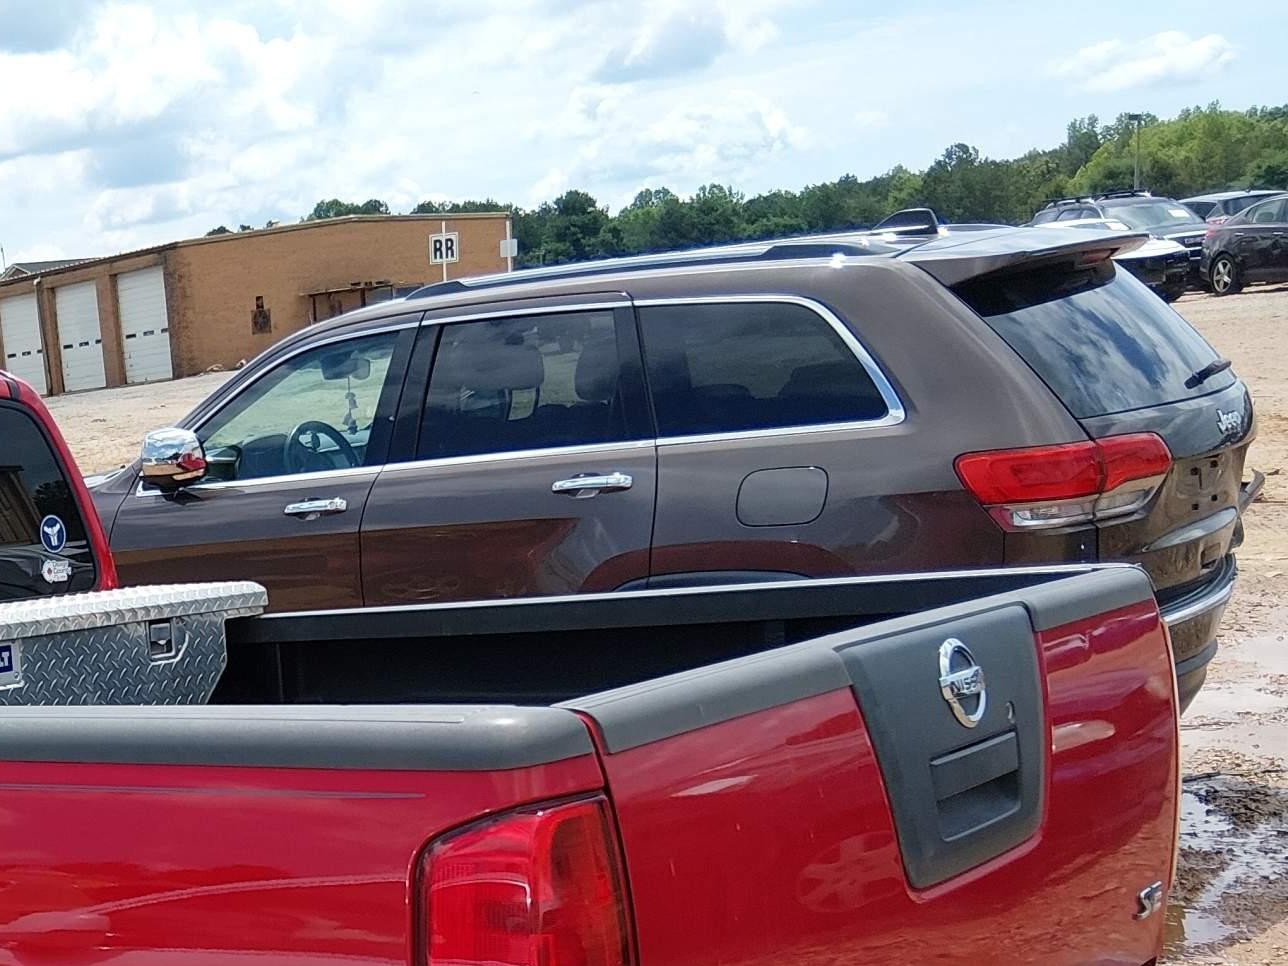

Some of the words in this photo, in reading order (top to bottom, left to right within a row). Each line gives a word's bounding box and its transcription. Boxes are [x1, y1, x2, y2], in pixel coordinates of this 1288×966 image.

[433, 237, 455, 260] RR
[1216, 409, 1242, 432] Jeep
[950, 668, 983, 693] NISS
